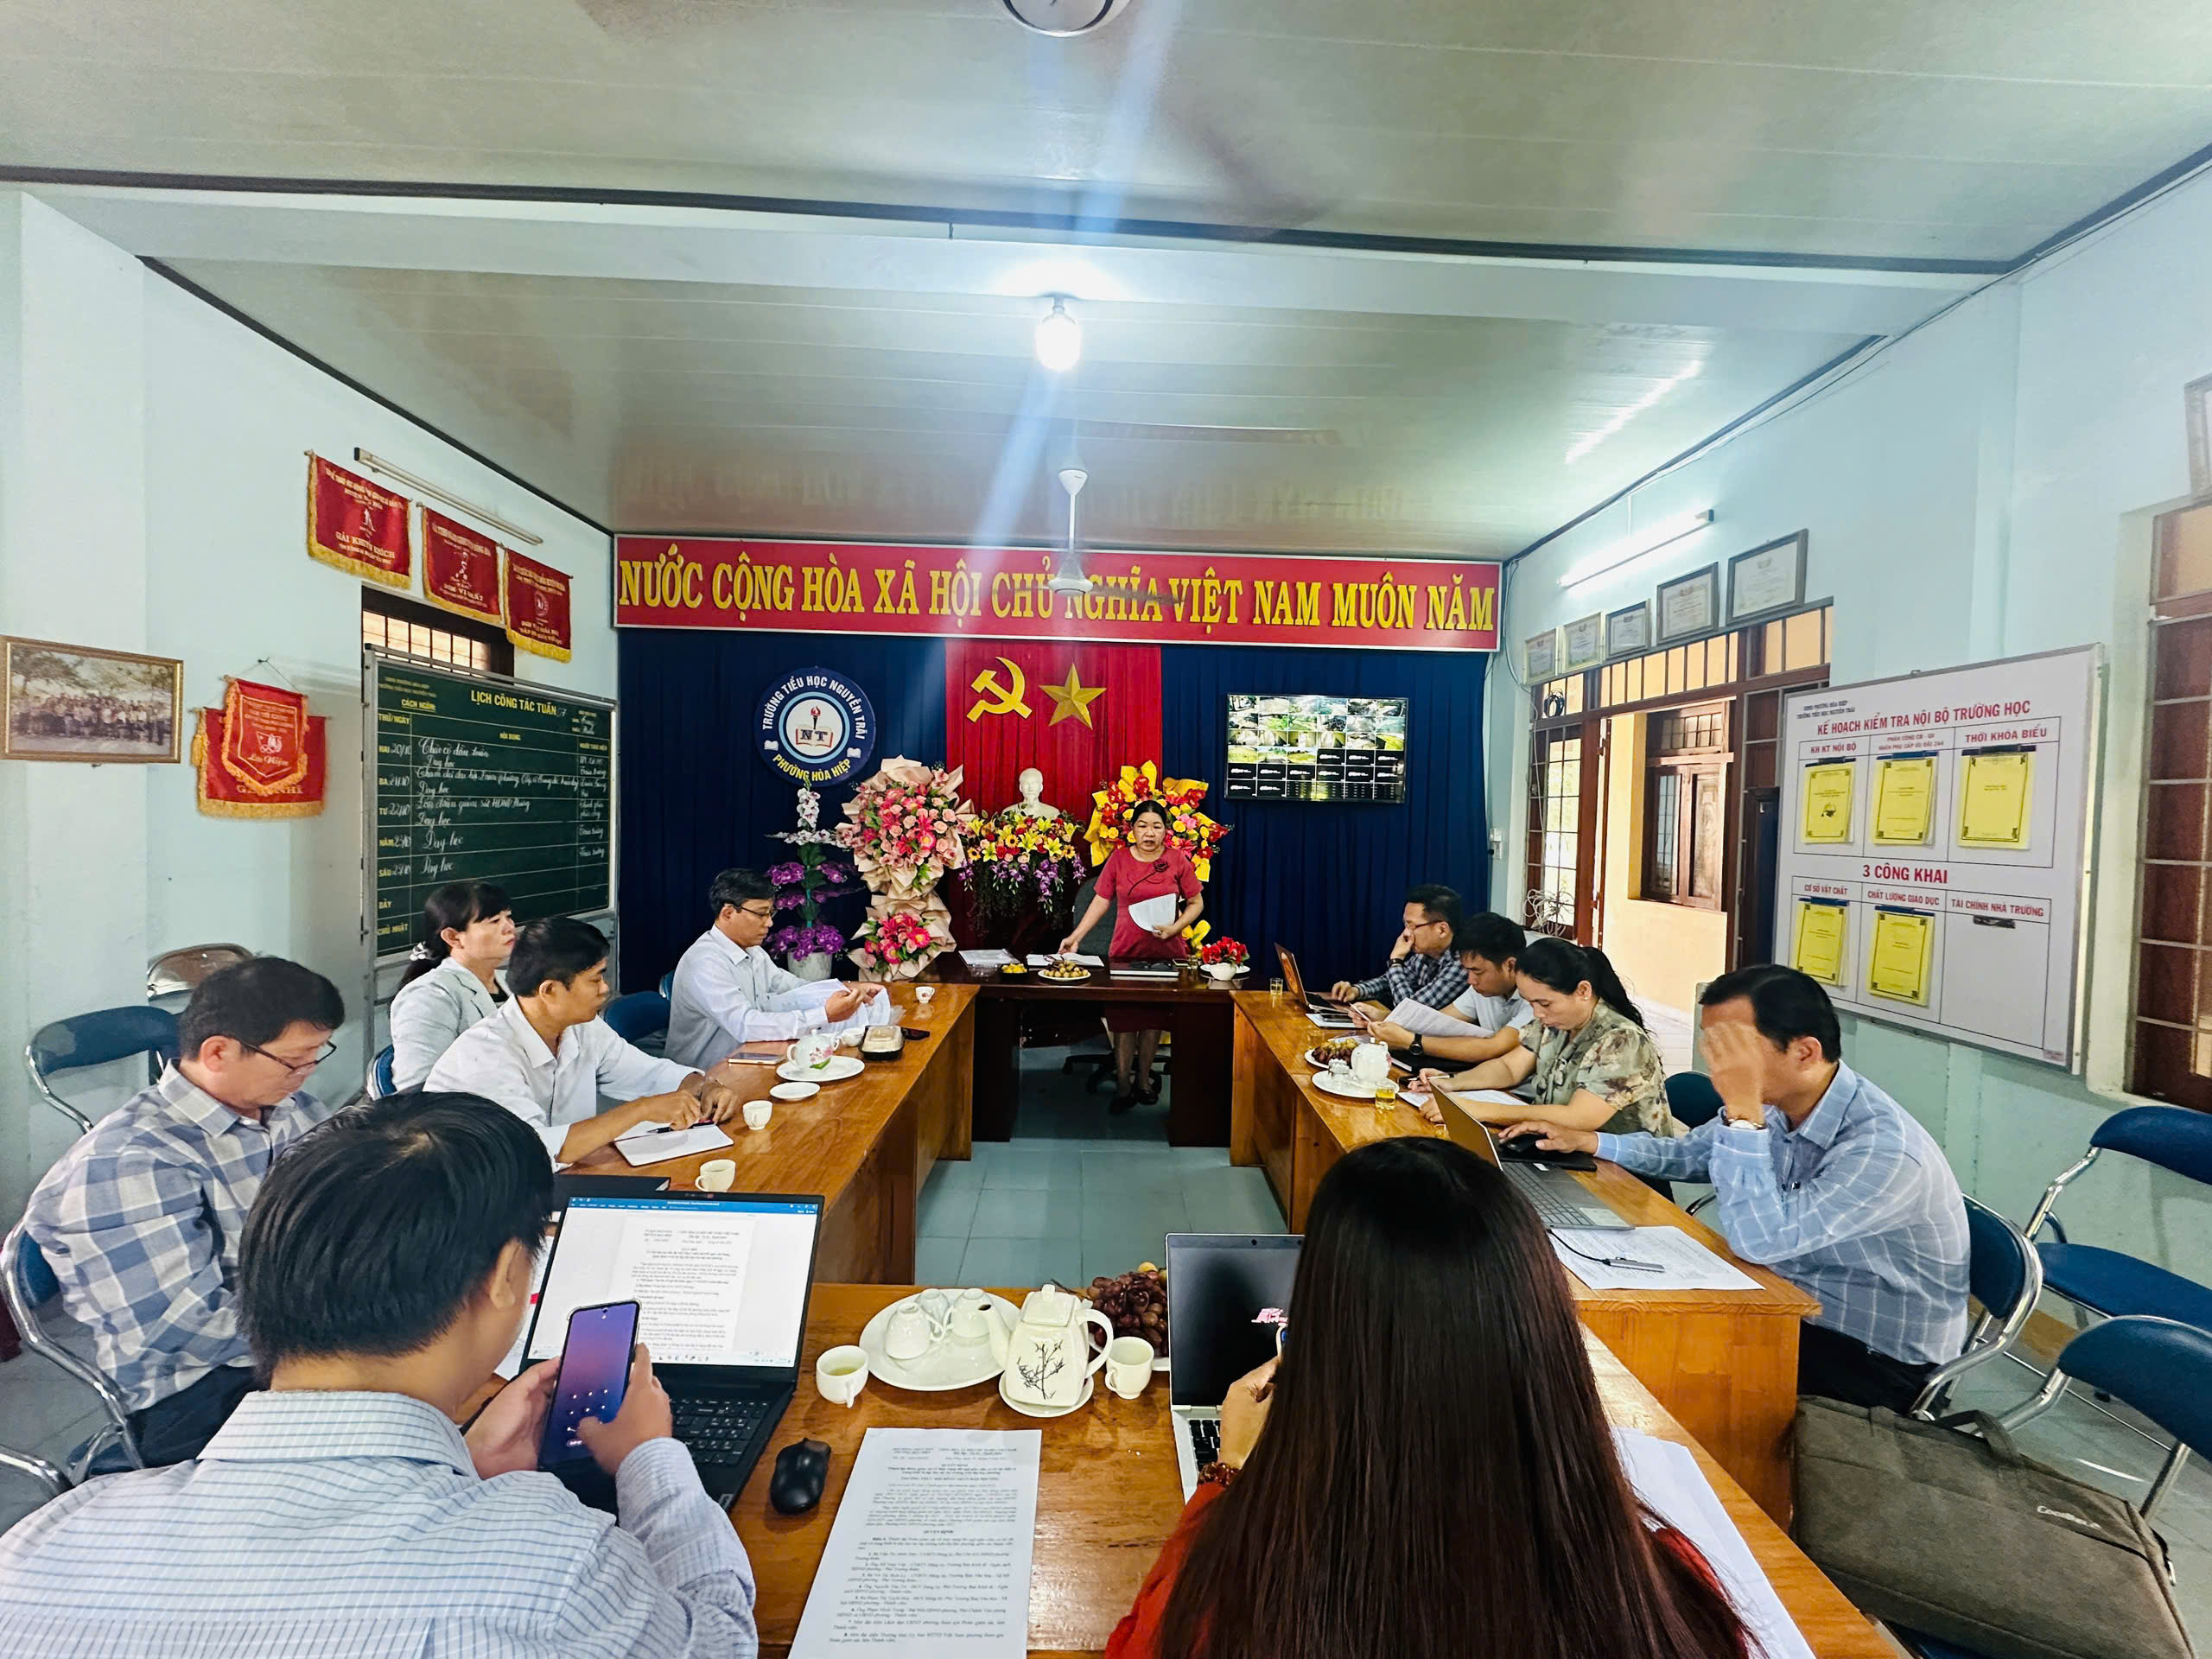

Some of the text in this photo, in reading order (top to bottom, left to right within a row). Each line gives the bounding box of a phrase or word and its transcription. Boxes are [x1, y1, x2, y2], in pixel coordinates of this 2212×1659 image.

[620, 543, 703, 608] NƯỚC
[712, 551, 794, 622] CỘNG
[802, 553, 864, 613] HÒA
[873, 558, 919, 616] XÃ
[929, 557, 982, 628] HỘI
[992, 556, 1056, 619] CHỦ
[1169, 566, 1243, 634] VIỆT
[1253, 580, 1320, 626] NAM
[1332, 572, 1417, 629] MUÔN
[1426, 574, 1495, 632] NĂM
[471, 690, 556, 715] LỊCH CÔNG TÁC TUẦN
[762, 675, 868, 740] TRƯỜNG TIỂU HỌC NGUYỄN TRÃI
[1818, 700, 2031, 735] KẾ HOẠCH KIỂM TRA NỘI BỘ TRƯỜNG HỌC
[1966, 731, 1987, 743] THỜI
[2022, 723, 2047, 739] BIỂU
[772, 753, 852, 782] PHƯỜNG HÒA HIỆP
[1863, 862, 1948, 884] 3 CÔNG KHAI
[1867, 888, 1883, 899] CHẤT
[1966, 899, 1987, 910] CHÍNH
[1991, 901, 2007, 912] NHÀ
